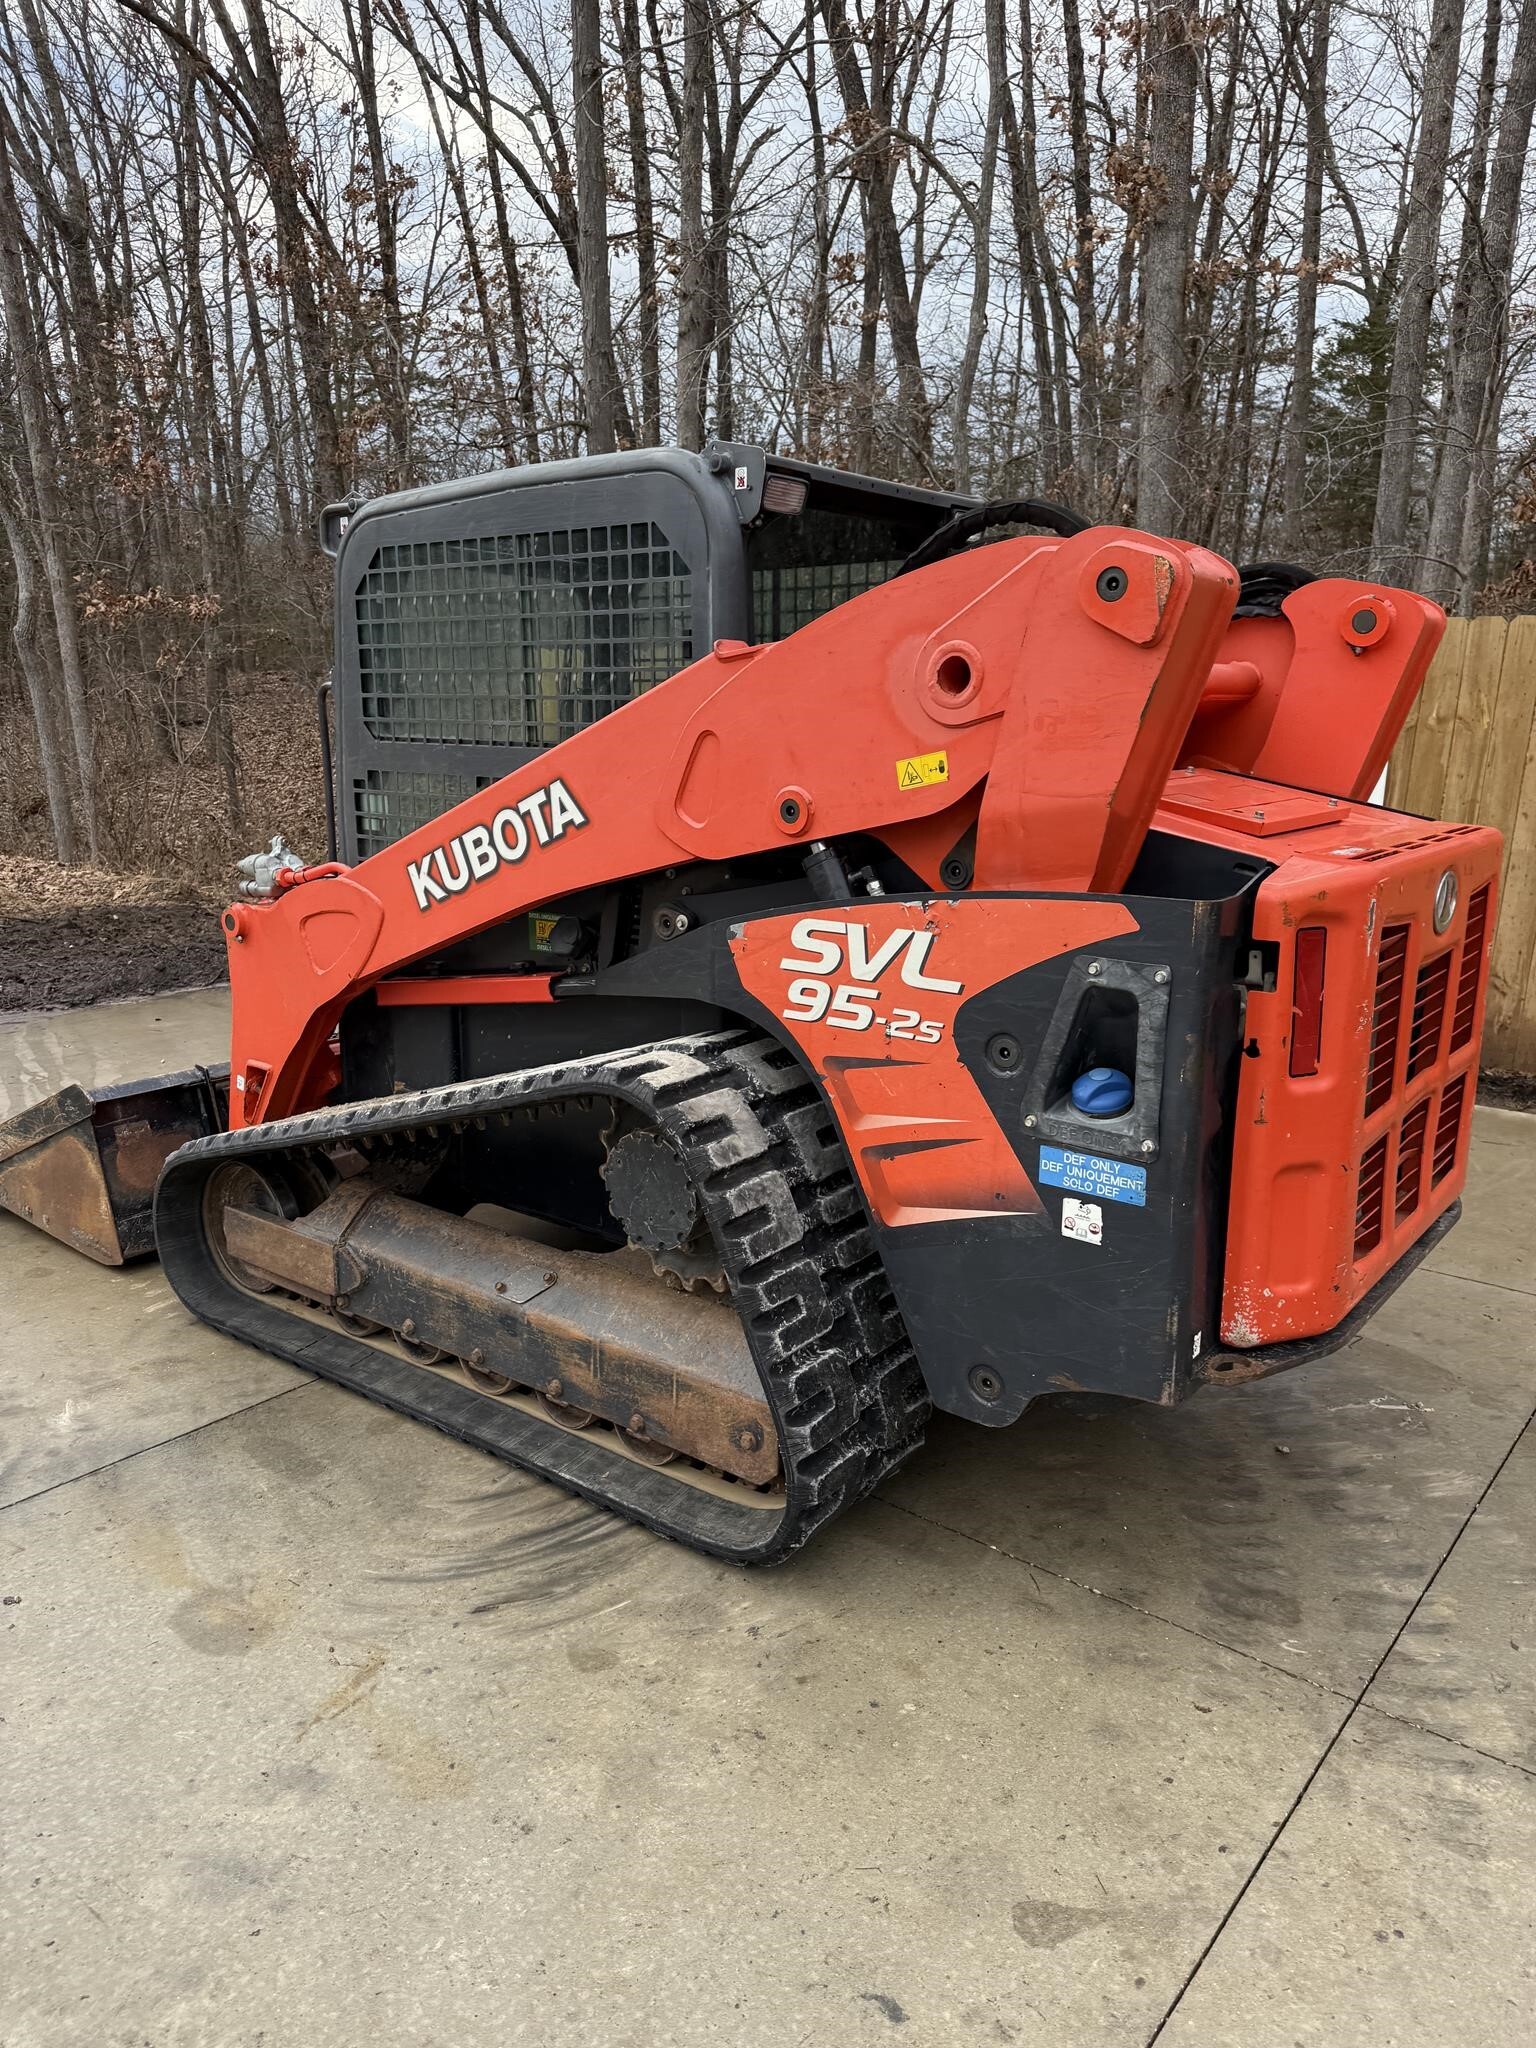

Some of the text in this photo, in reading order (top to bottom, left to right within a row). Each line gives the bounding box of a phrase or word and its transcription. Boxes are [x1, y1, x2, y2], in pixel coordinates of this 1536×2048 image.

[407, 779, 587, 910] KUBOTA
[780, 918, 963, 994] SVL
[1048, 1121, 1079, 1140] DEF
[1041, 1160, 1144, 1191] DEF UNIQUEMENT
[1063, 1153, 1120, 1174] DEF ONLY
[1063, 1177, 1120, 1197] SOLO DEF
